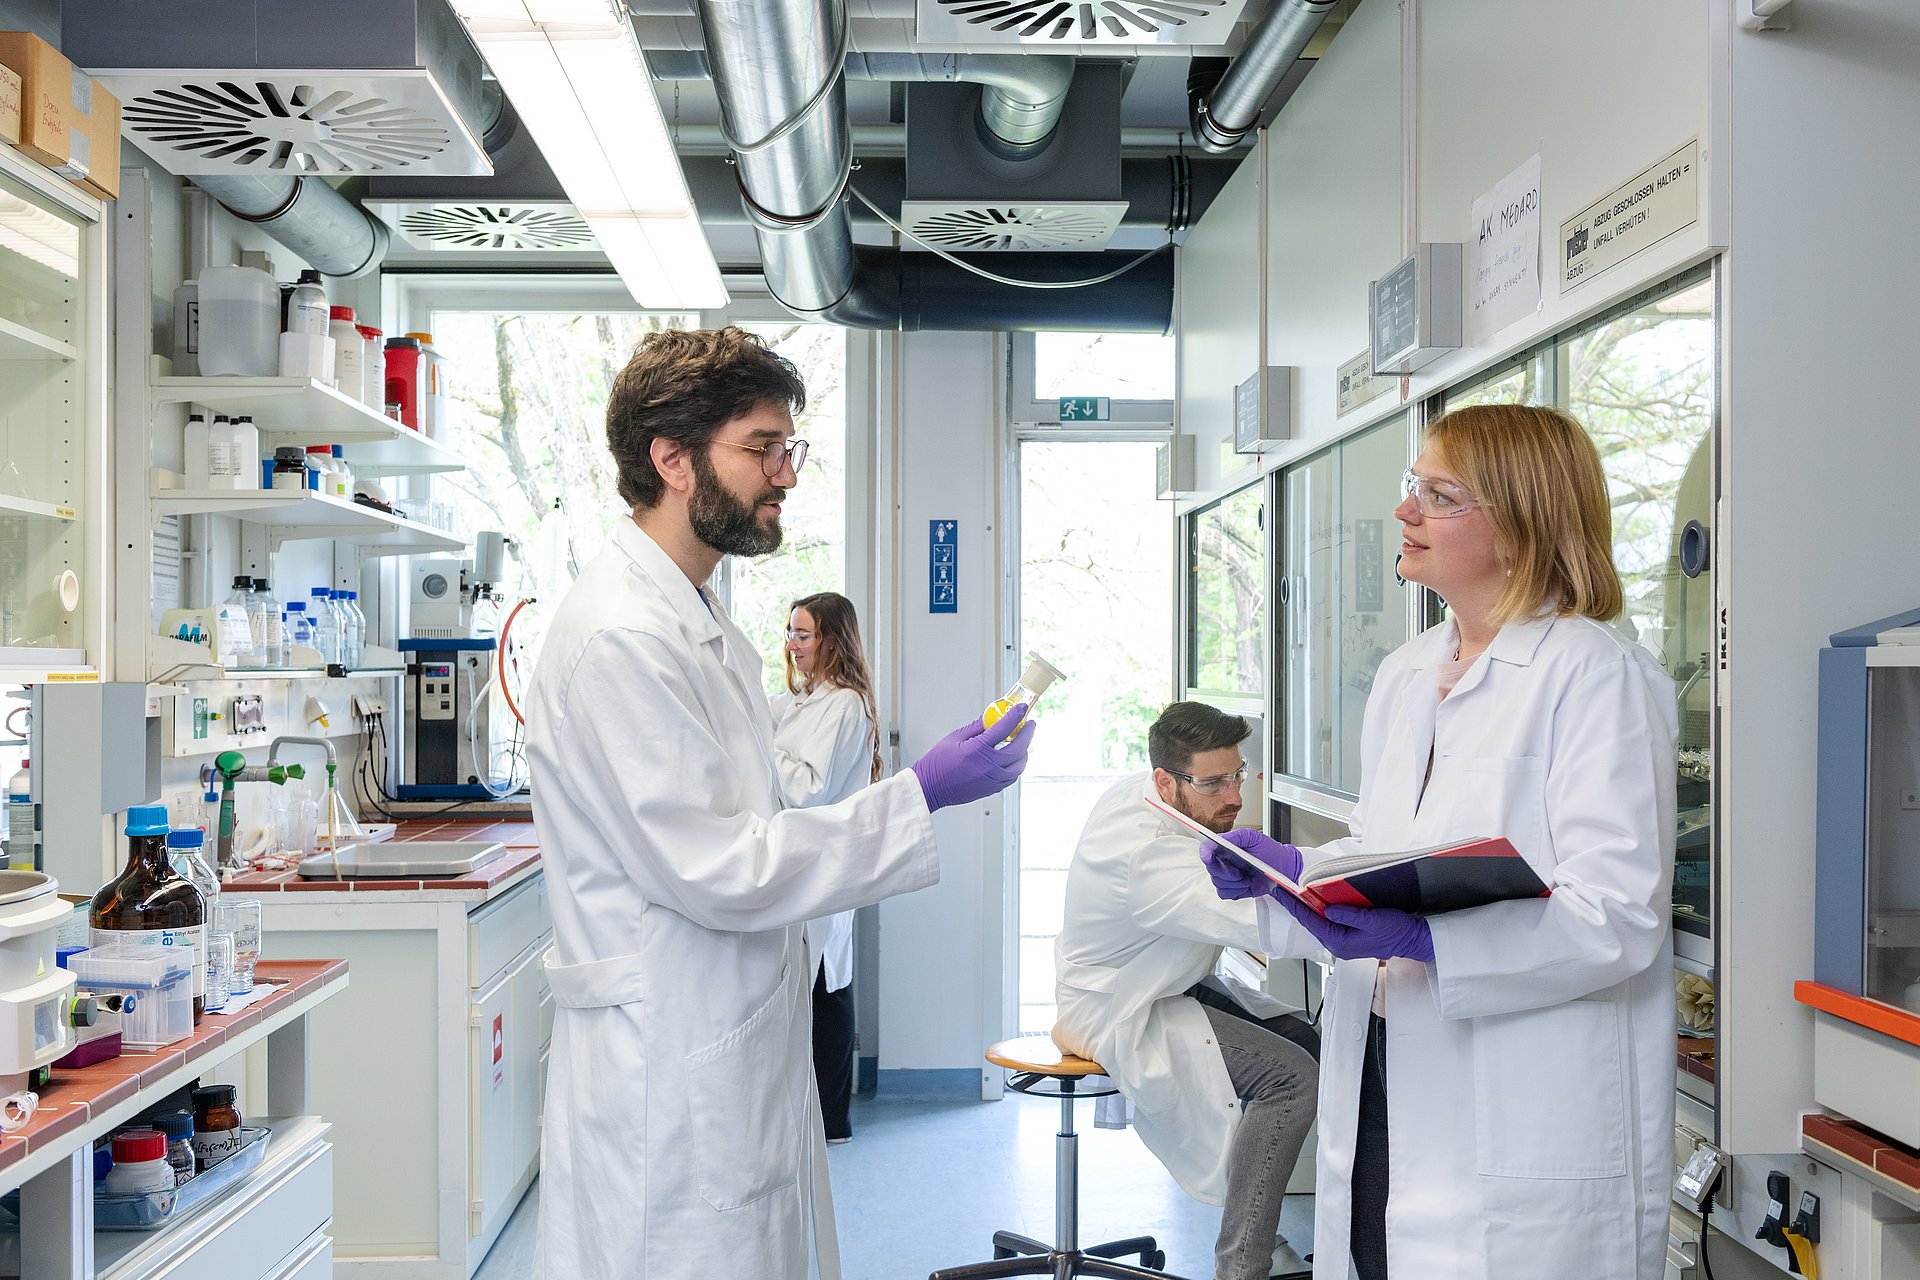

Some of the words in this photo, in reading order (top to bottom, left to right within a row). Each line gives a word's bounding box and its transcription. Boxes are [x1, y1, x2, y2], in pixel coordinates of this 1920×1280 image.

[1593, 209, 1611, 229] ABZUG
[1613, 182, 1654, 217] GESCHLOSSEN
[1657, 166, 1681, 190] HALTEN
[1479, 211, 1493, 247] AK
[1500, 188, 1538, 234] MEDARD
[1594, 231, 1613, 250] UNFALL
[1566, 263, 1584, 281] ABZUG
